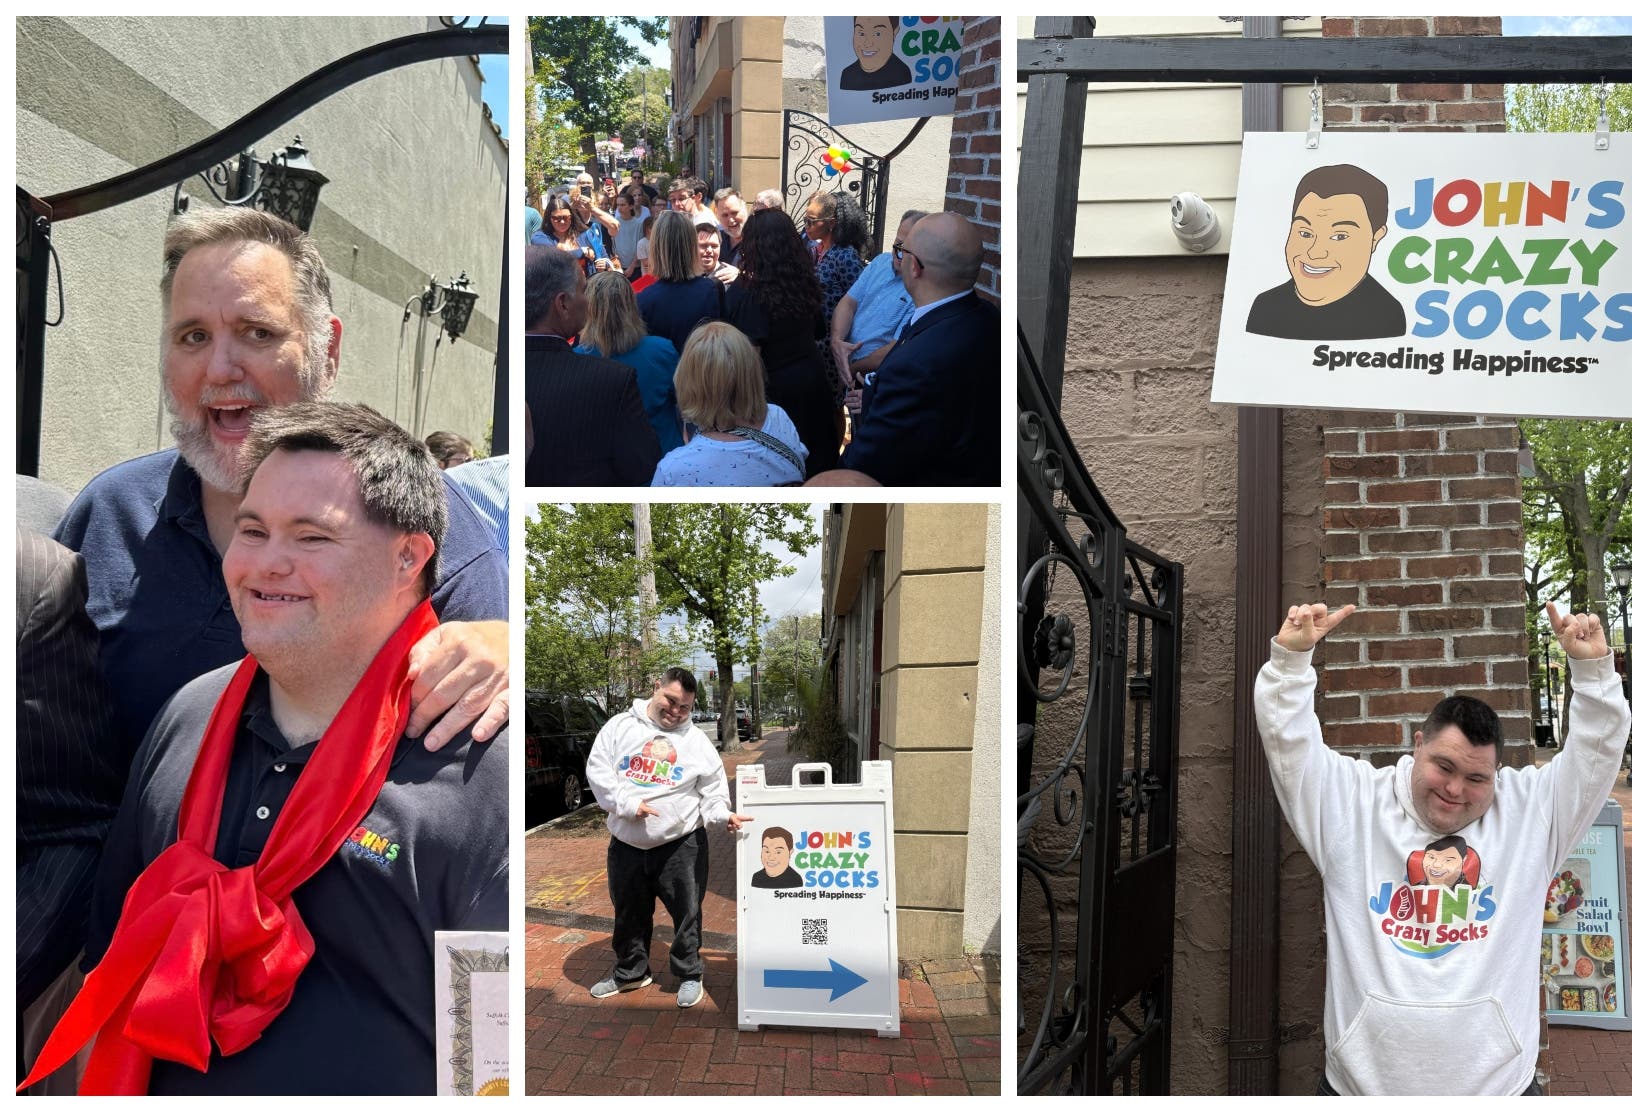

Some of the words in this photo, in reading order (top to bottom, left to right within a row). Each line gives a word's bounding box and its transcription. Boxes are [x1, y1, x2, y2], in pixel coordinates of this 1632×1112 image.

[872, 87, 929, 104] Spreading
[1395, 177, 1626, 230] JOHN'S
[1388, 236, 1618, 286] CRAZY
[1312, 345, 1444, 375] Spreading
[626, 770, 648, 782] Crazy
[350, 826, 401, 861] OHN'S
[795, 831, 871, 850] JOHN'S
[794, 852, 870, 869] CRAZY
[805, 871, 879, 888] SOCKS
[774, 890, 817, 900] Spreading
[1369, 882, 1496, 924] JOHN'S
[1577, 909, 1612, 920] Salad
[1381, 918, 1430, 945] Crazy
[1436, 923, 1488, 943] Socks
[1577, 922, 1609, 932] Bowl
